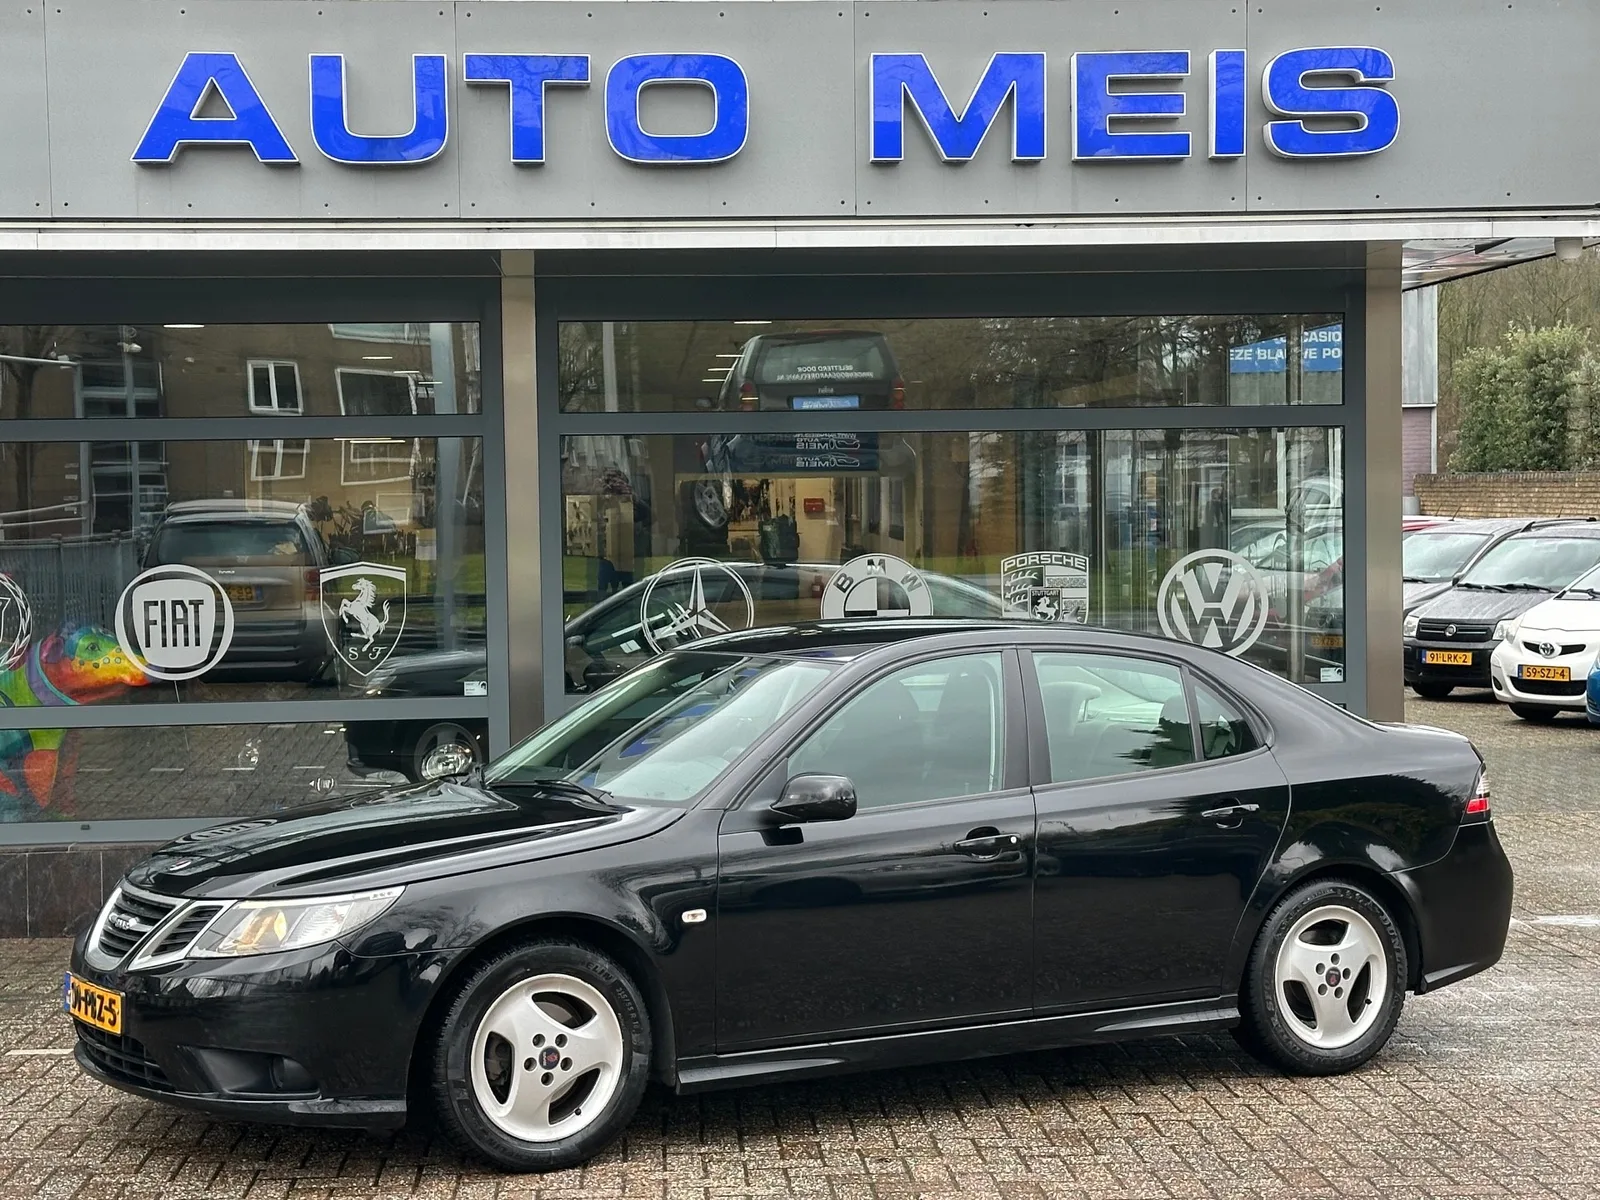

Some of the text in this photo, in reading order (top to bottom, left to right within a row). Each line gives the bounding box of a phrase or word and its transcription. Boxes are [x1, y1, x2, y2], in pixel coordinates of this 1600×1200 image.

[130, 45, 1402, 166] AUTO MEIS
[1257, 347, 1317, 361] BLAE
[1003, 553, 1086, 572] PORSCHE
[1031, 589, 1060, 597] STUTTGART
[143, 598, 205, 649] FIAT
[348, 646, 358, 661] S
[1429, 652, 1468, 664] 91-LRK-2
[1526, 667, 1566, 680] 59-SZJ-4
